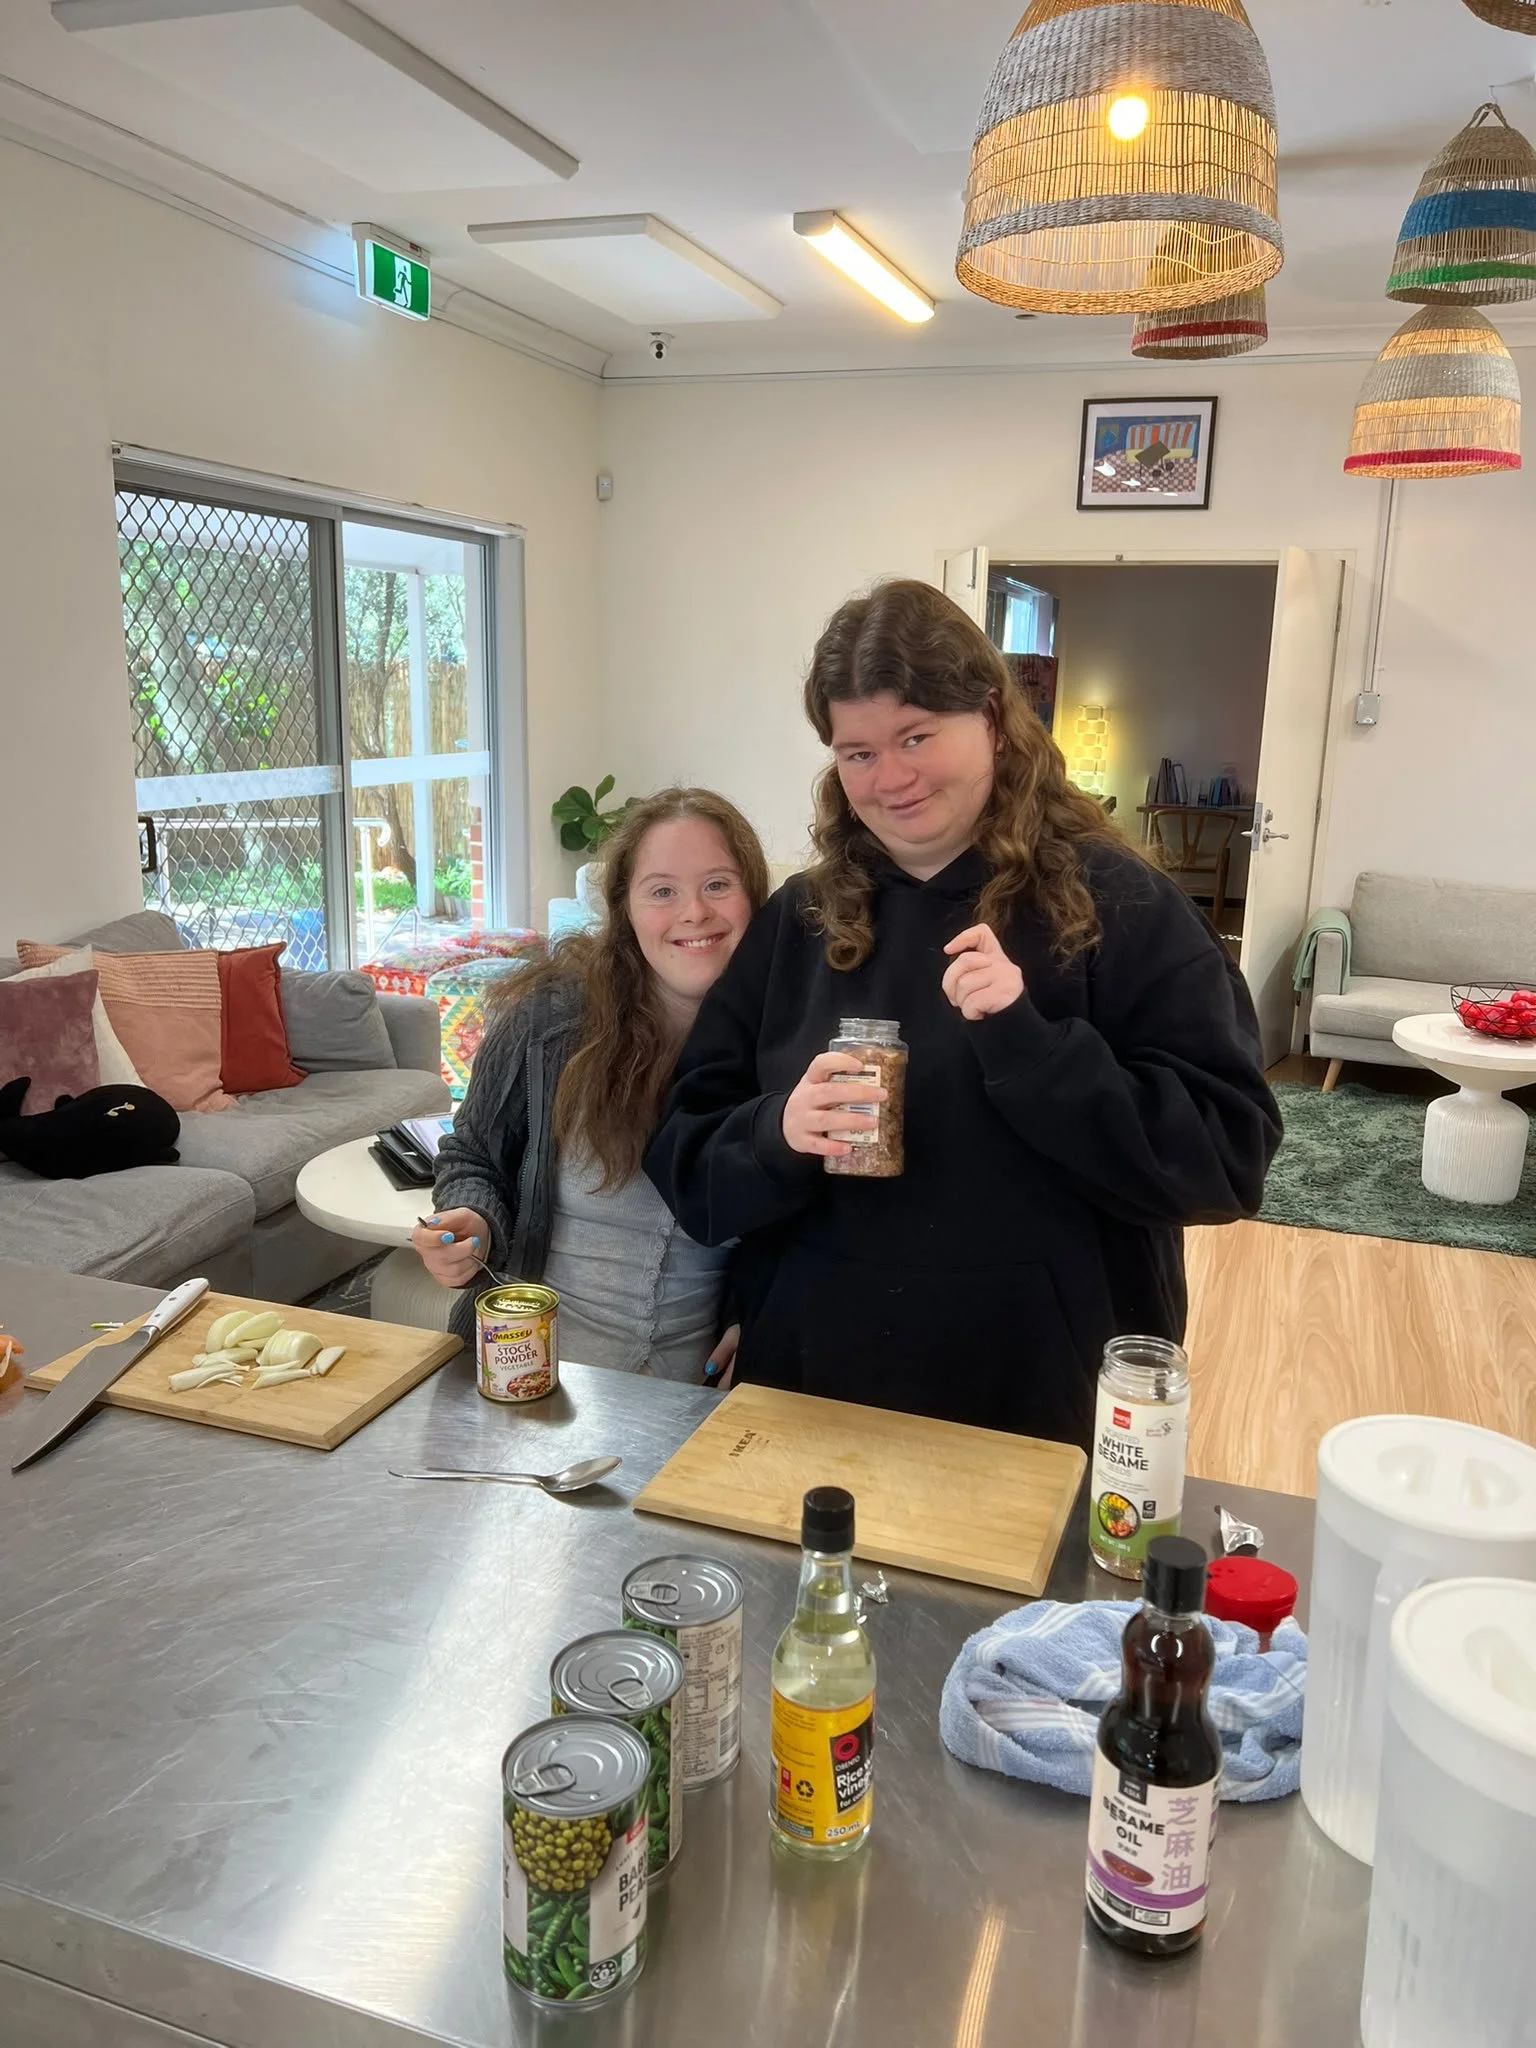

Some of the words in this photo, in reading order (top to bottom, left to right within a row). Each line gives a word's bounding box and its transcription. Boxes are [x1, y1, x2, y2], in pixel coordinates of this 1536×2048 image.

[494, 1329, 533, 1341] MASSEL
[495, 1350, 538, 1364] POWDER
[498, 1343, 532, 1356] STOCK
[500, 1361, 534, 1371] VEGETABLE
[729, 1432, 756, 1457] IKEA
[1102, 1433, 1144, 1458] WHITE
[1098, 1443, 1149, 1471] SESAME
[835, 1755, 861, 1772] OBENTO
[836, 1767, 863, 1788] Rice
[840, 1799, 851, 1808] for
[1103, 1796, 1165, 1836] SESAME
[827, 1826, 846, 1837] 250
[1116, 1825, 1142, 1847] OIL
[1161, 1796, 1200, 1891] 芝麻油
